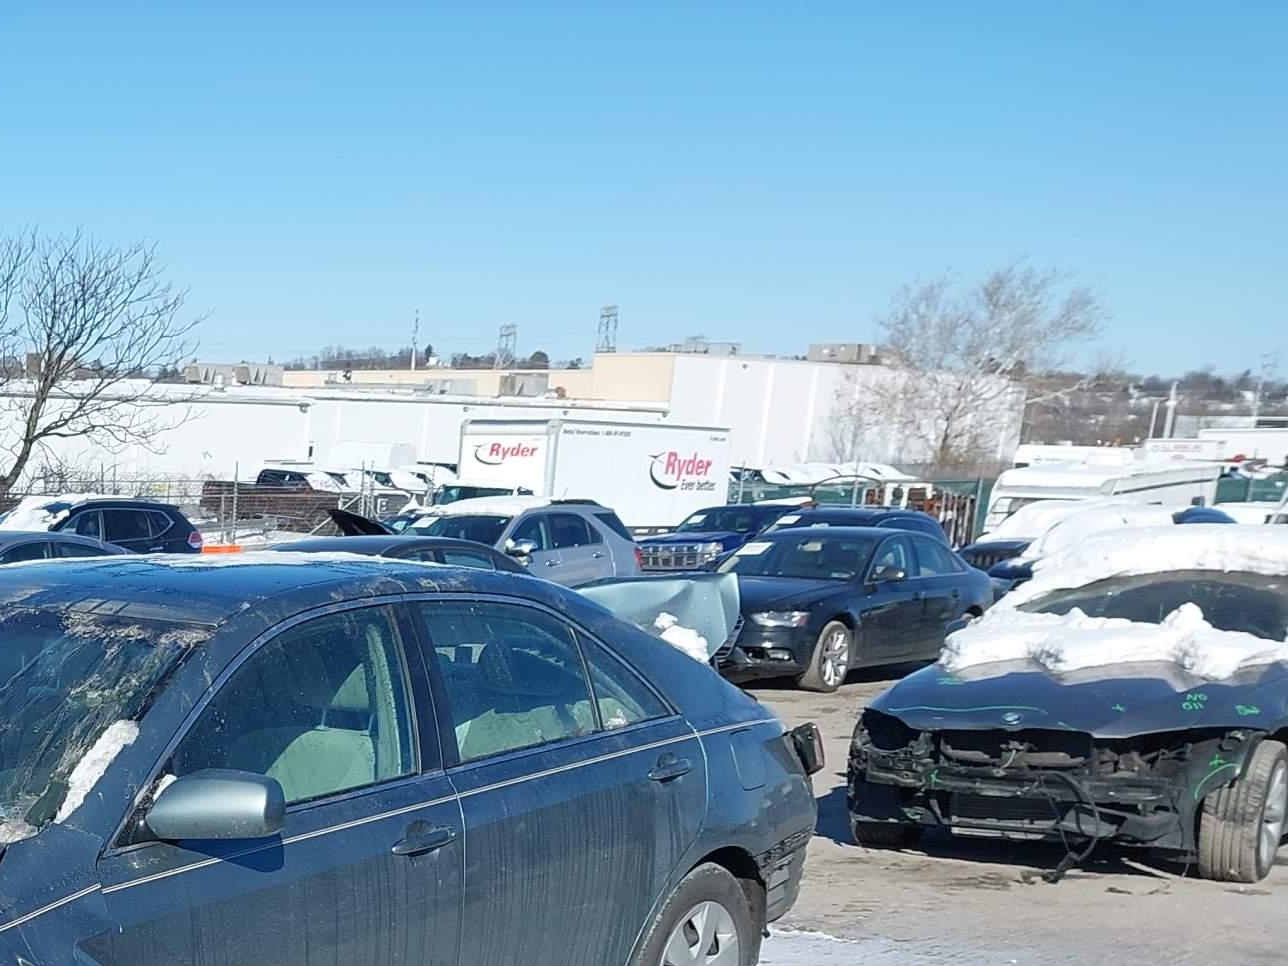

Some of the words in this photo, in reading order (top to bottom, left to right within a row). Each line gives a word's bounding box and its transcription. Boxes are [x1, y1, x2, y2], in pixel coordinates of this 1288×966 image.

[489, 442, 538, 460] Ryder
[664, 452, 712, 481] Ryder
[681, 479, 696, 490] Ever
